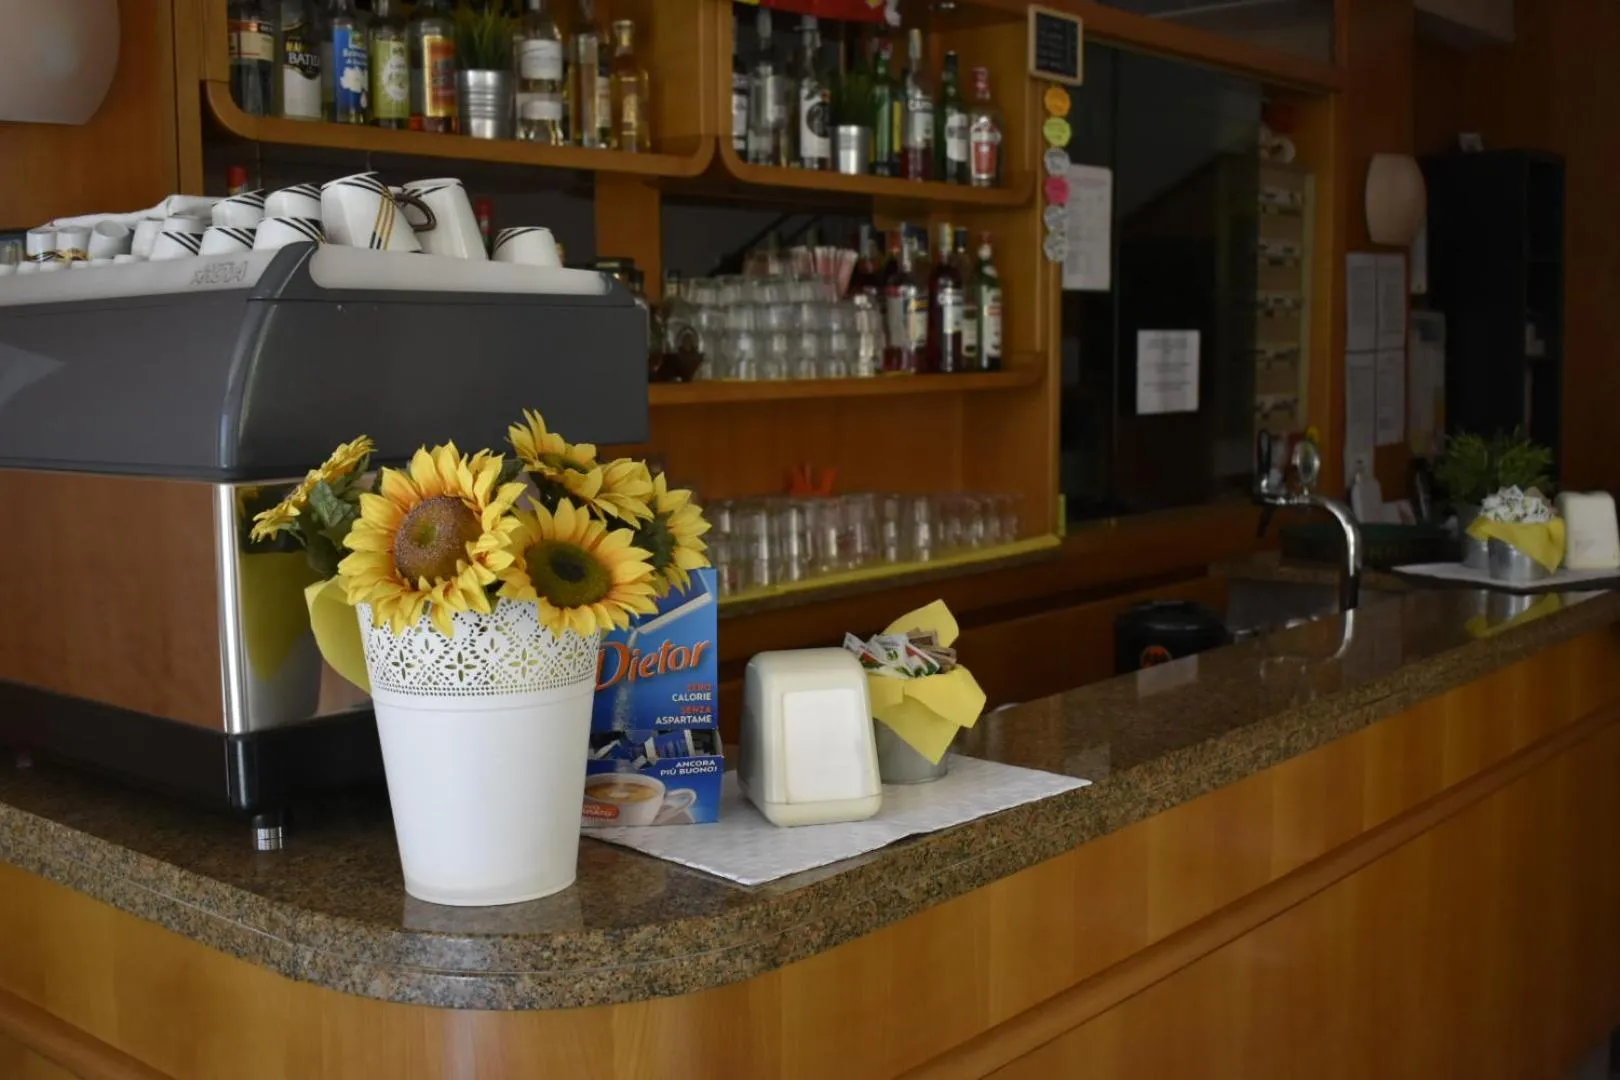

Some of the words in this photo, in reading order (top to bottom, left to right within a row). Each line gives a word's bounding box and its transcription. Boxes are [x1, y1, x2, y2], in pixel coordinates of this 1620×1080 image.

[595, 639, 710, 692] Dietor
[672, 692, 712, 702] CALORIE
[655, 714, 712, 725] ASPARTAME
[675, 759, 716, 768] ANCORA
[679, 766, 718, 775] BUONO!
